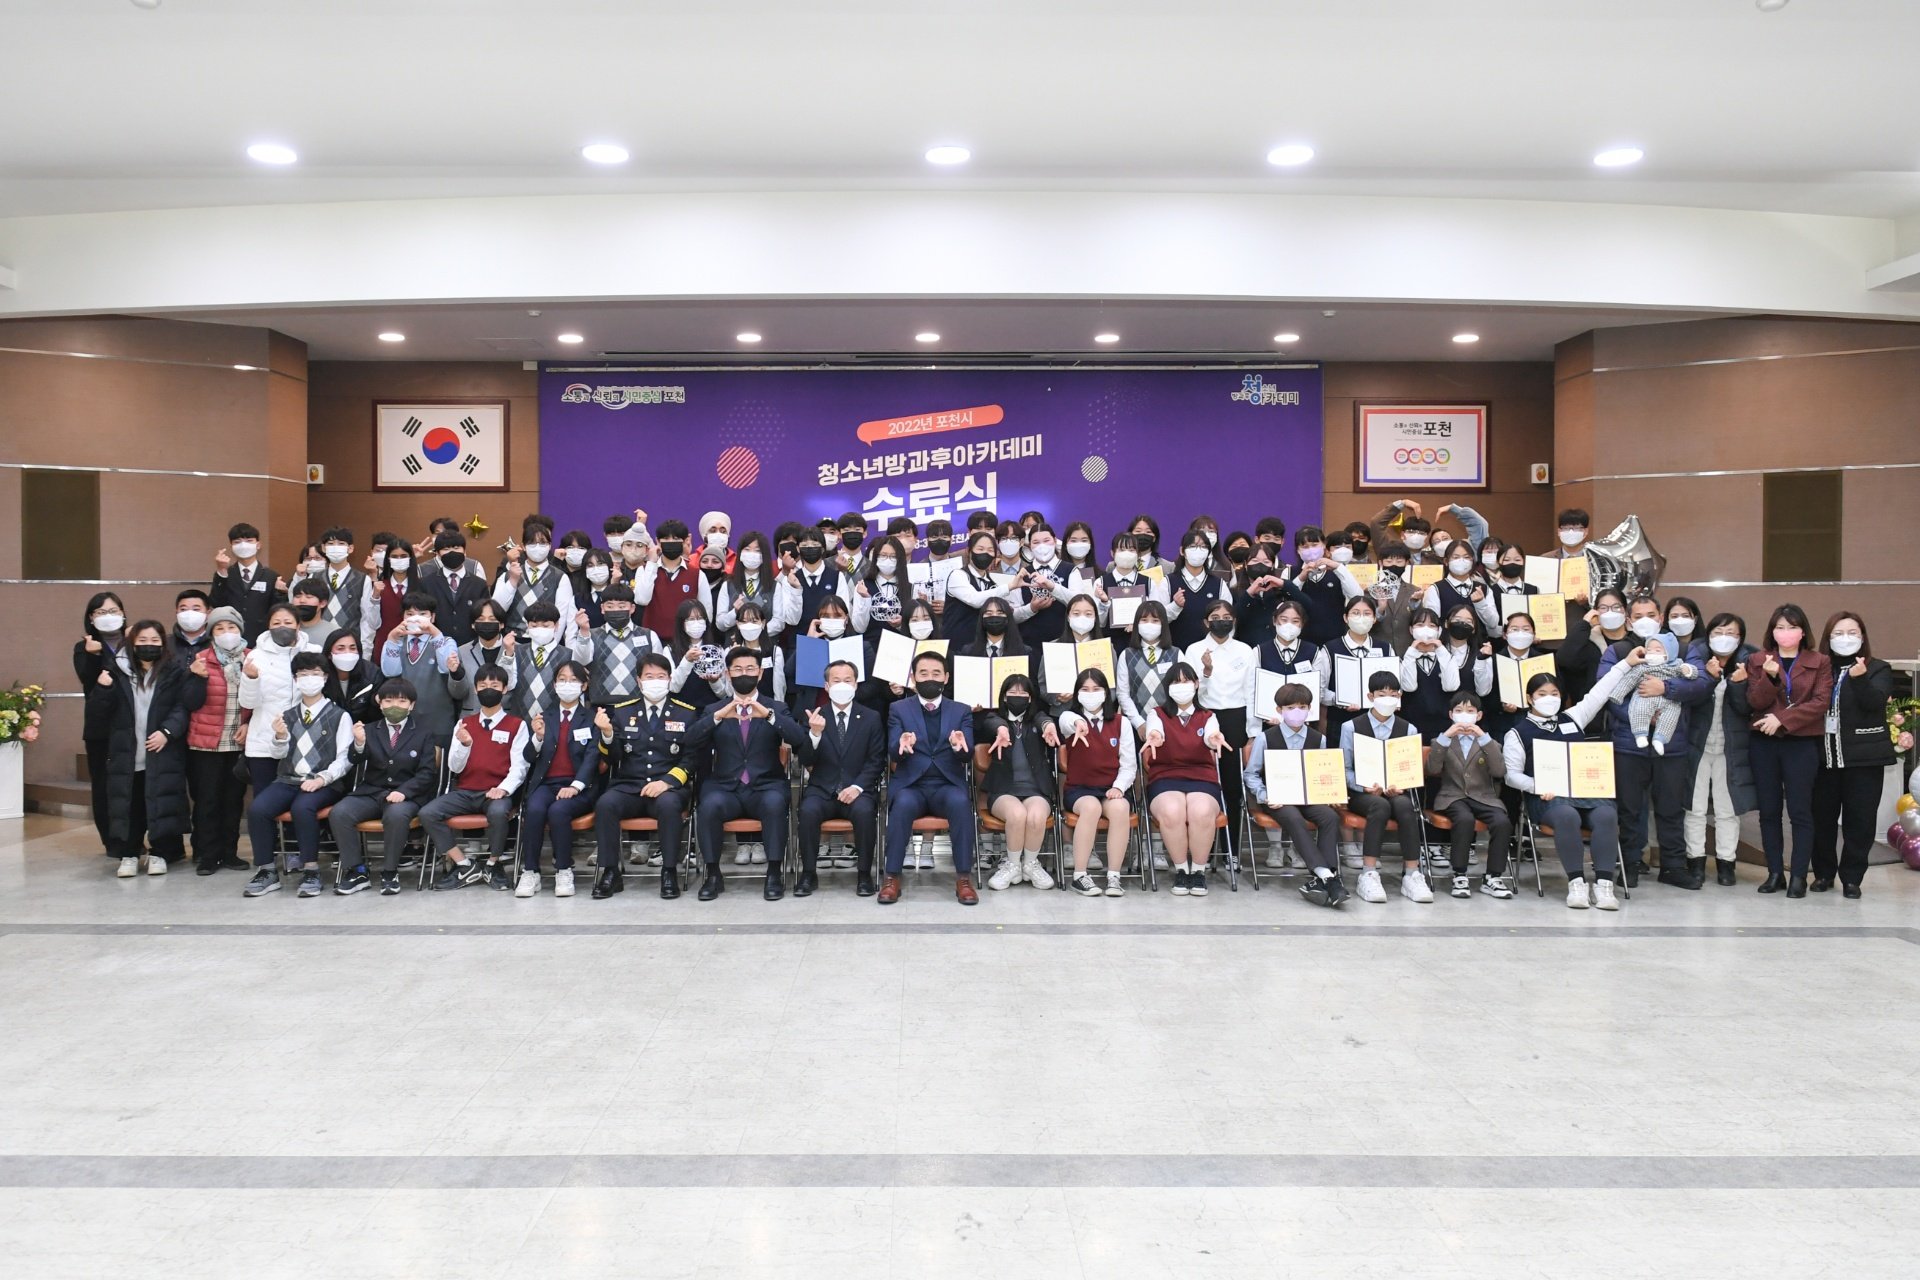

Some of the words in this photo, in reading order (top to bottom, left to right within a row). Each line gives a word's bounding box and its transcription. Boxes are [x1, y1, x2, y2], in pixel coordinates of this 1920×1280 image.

[592, 390, 620, 403] 신뢰의
[621, 390, 661, 403] 시민중심
[663, 389, 685, 403] 포천
[888, 417, 933, 435] 2022년
[936, 411, 973, 428] 포천시
[1422, 421, 1451, 437] 포천
[818, 434, 1042, 486] 청소년방과후아카데미
[862, 472, 997, 532] 수료식
